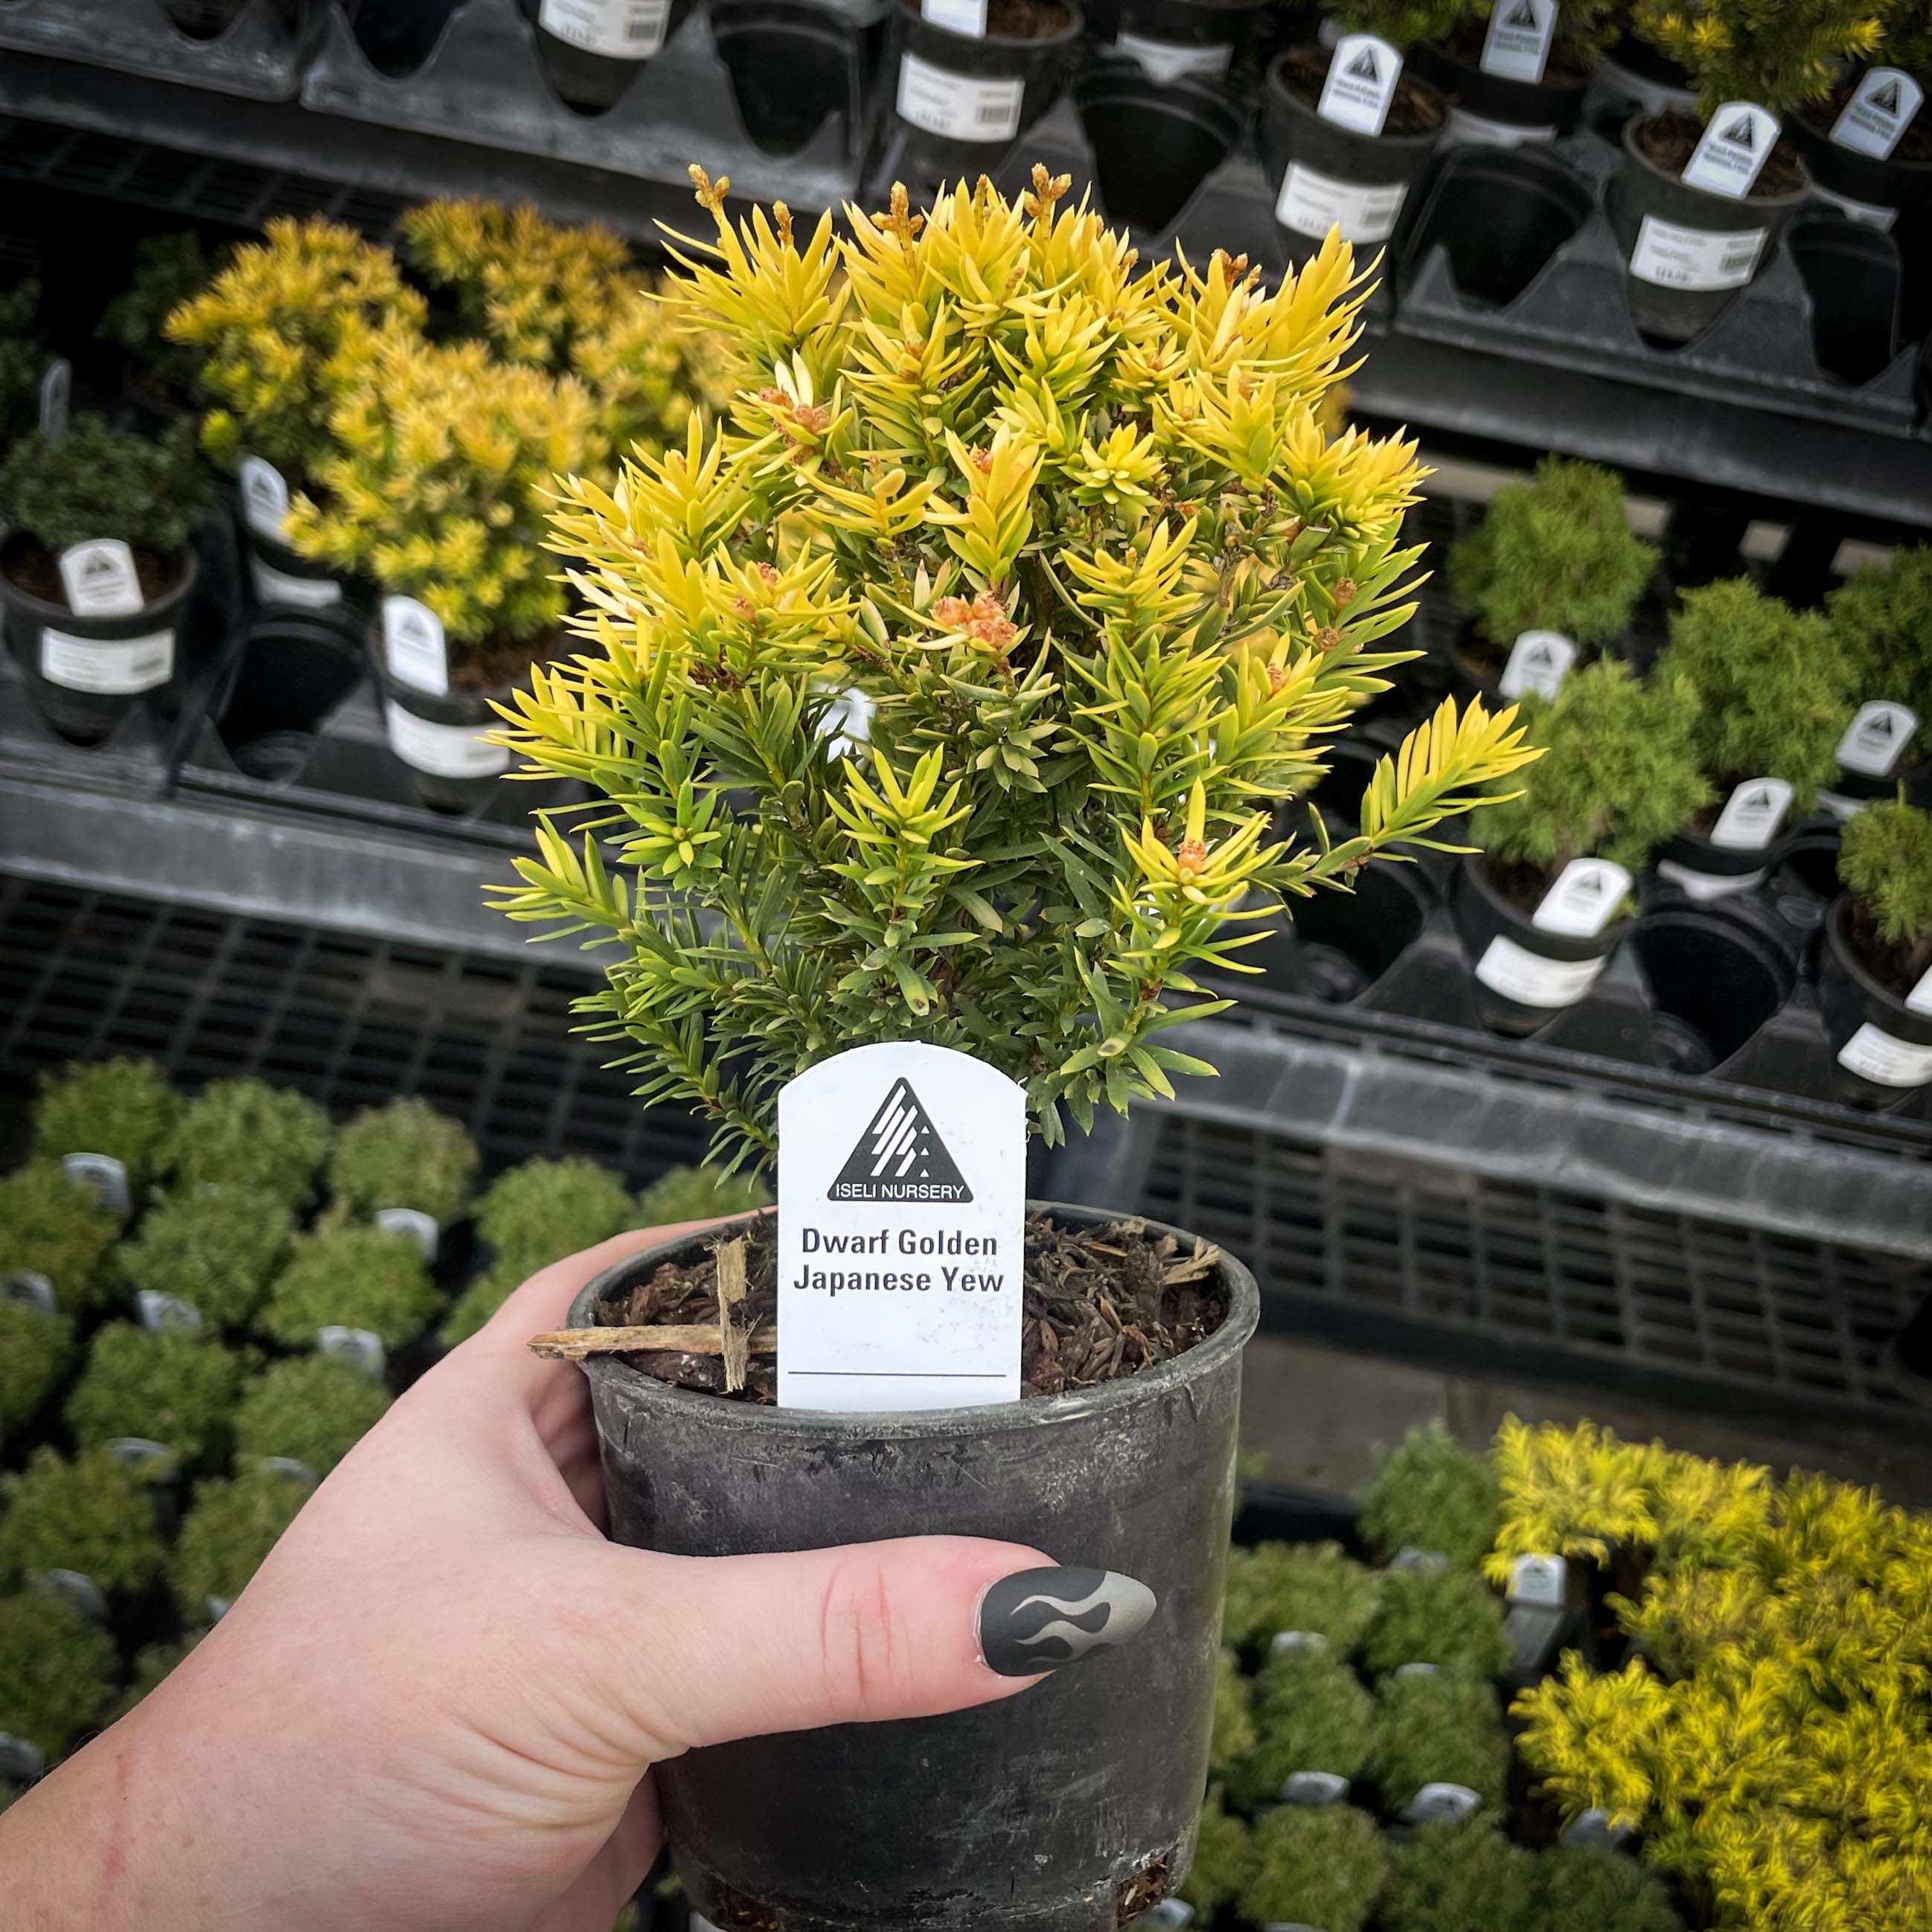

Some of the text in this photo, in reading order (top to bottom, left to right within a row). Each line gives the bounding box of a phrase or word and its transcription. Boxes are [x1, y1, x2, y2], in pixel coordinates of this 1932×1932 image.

[835, 1183, 965, 1200] ISELI NURSERY
[802, 1228, 997, 1256] Dwarf Golden
[793, 1264, 1005, 1297] Japanese Yew
